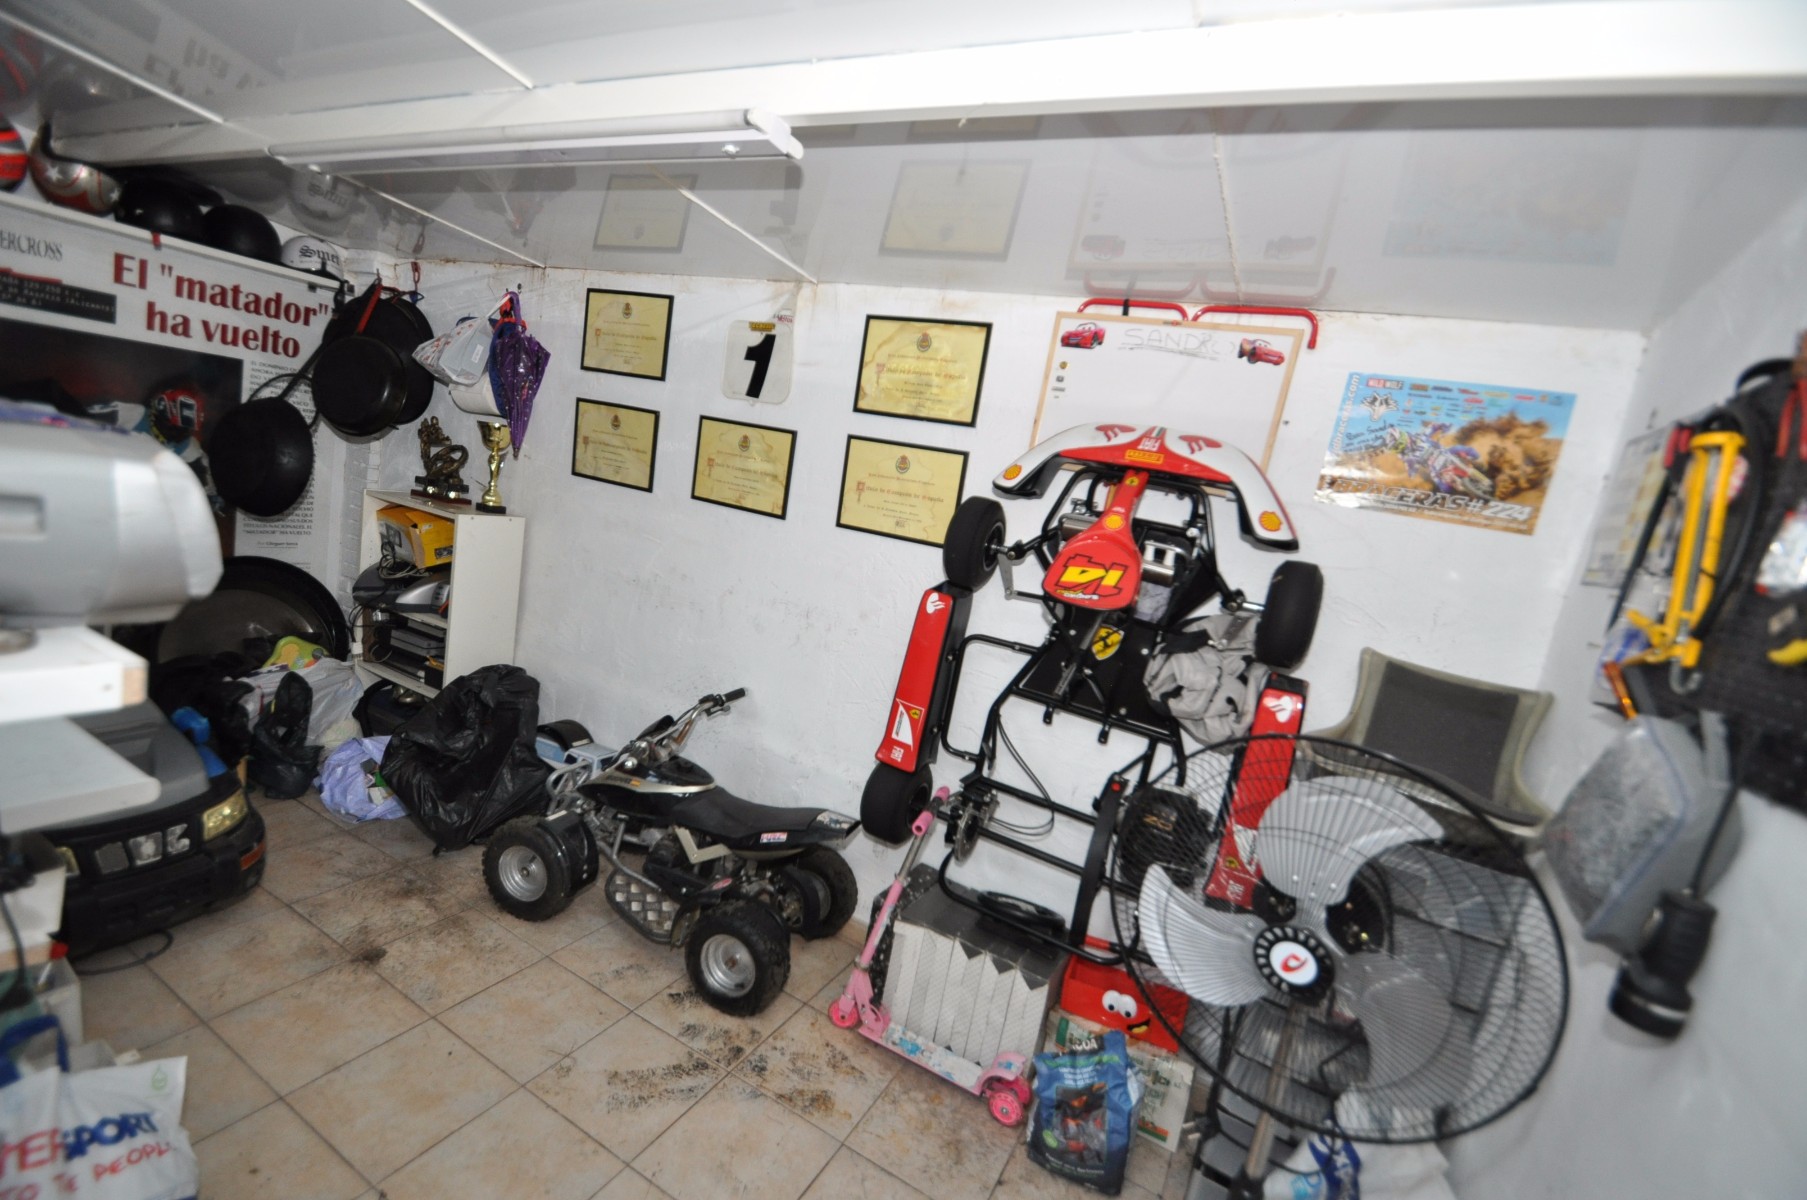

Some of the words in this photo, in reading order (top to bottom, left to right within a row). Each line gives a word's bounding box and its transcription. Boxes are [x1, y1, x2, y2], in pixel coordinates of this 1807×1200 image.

[113, 252, 148, 290] El
[161, 263, 329, 327] "matador"
[146, 301, 192, 338] ha
[201, 320, 300, 358] vuelto
[744, 333, 776, 398] 1
